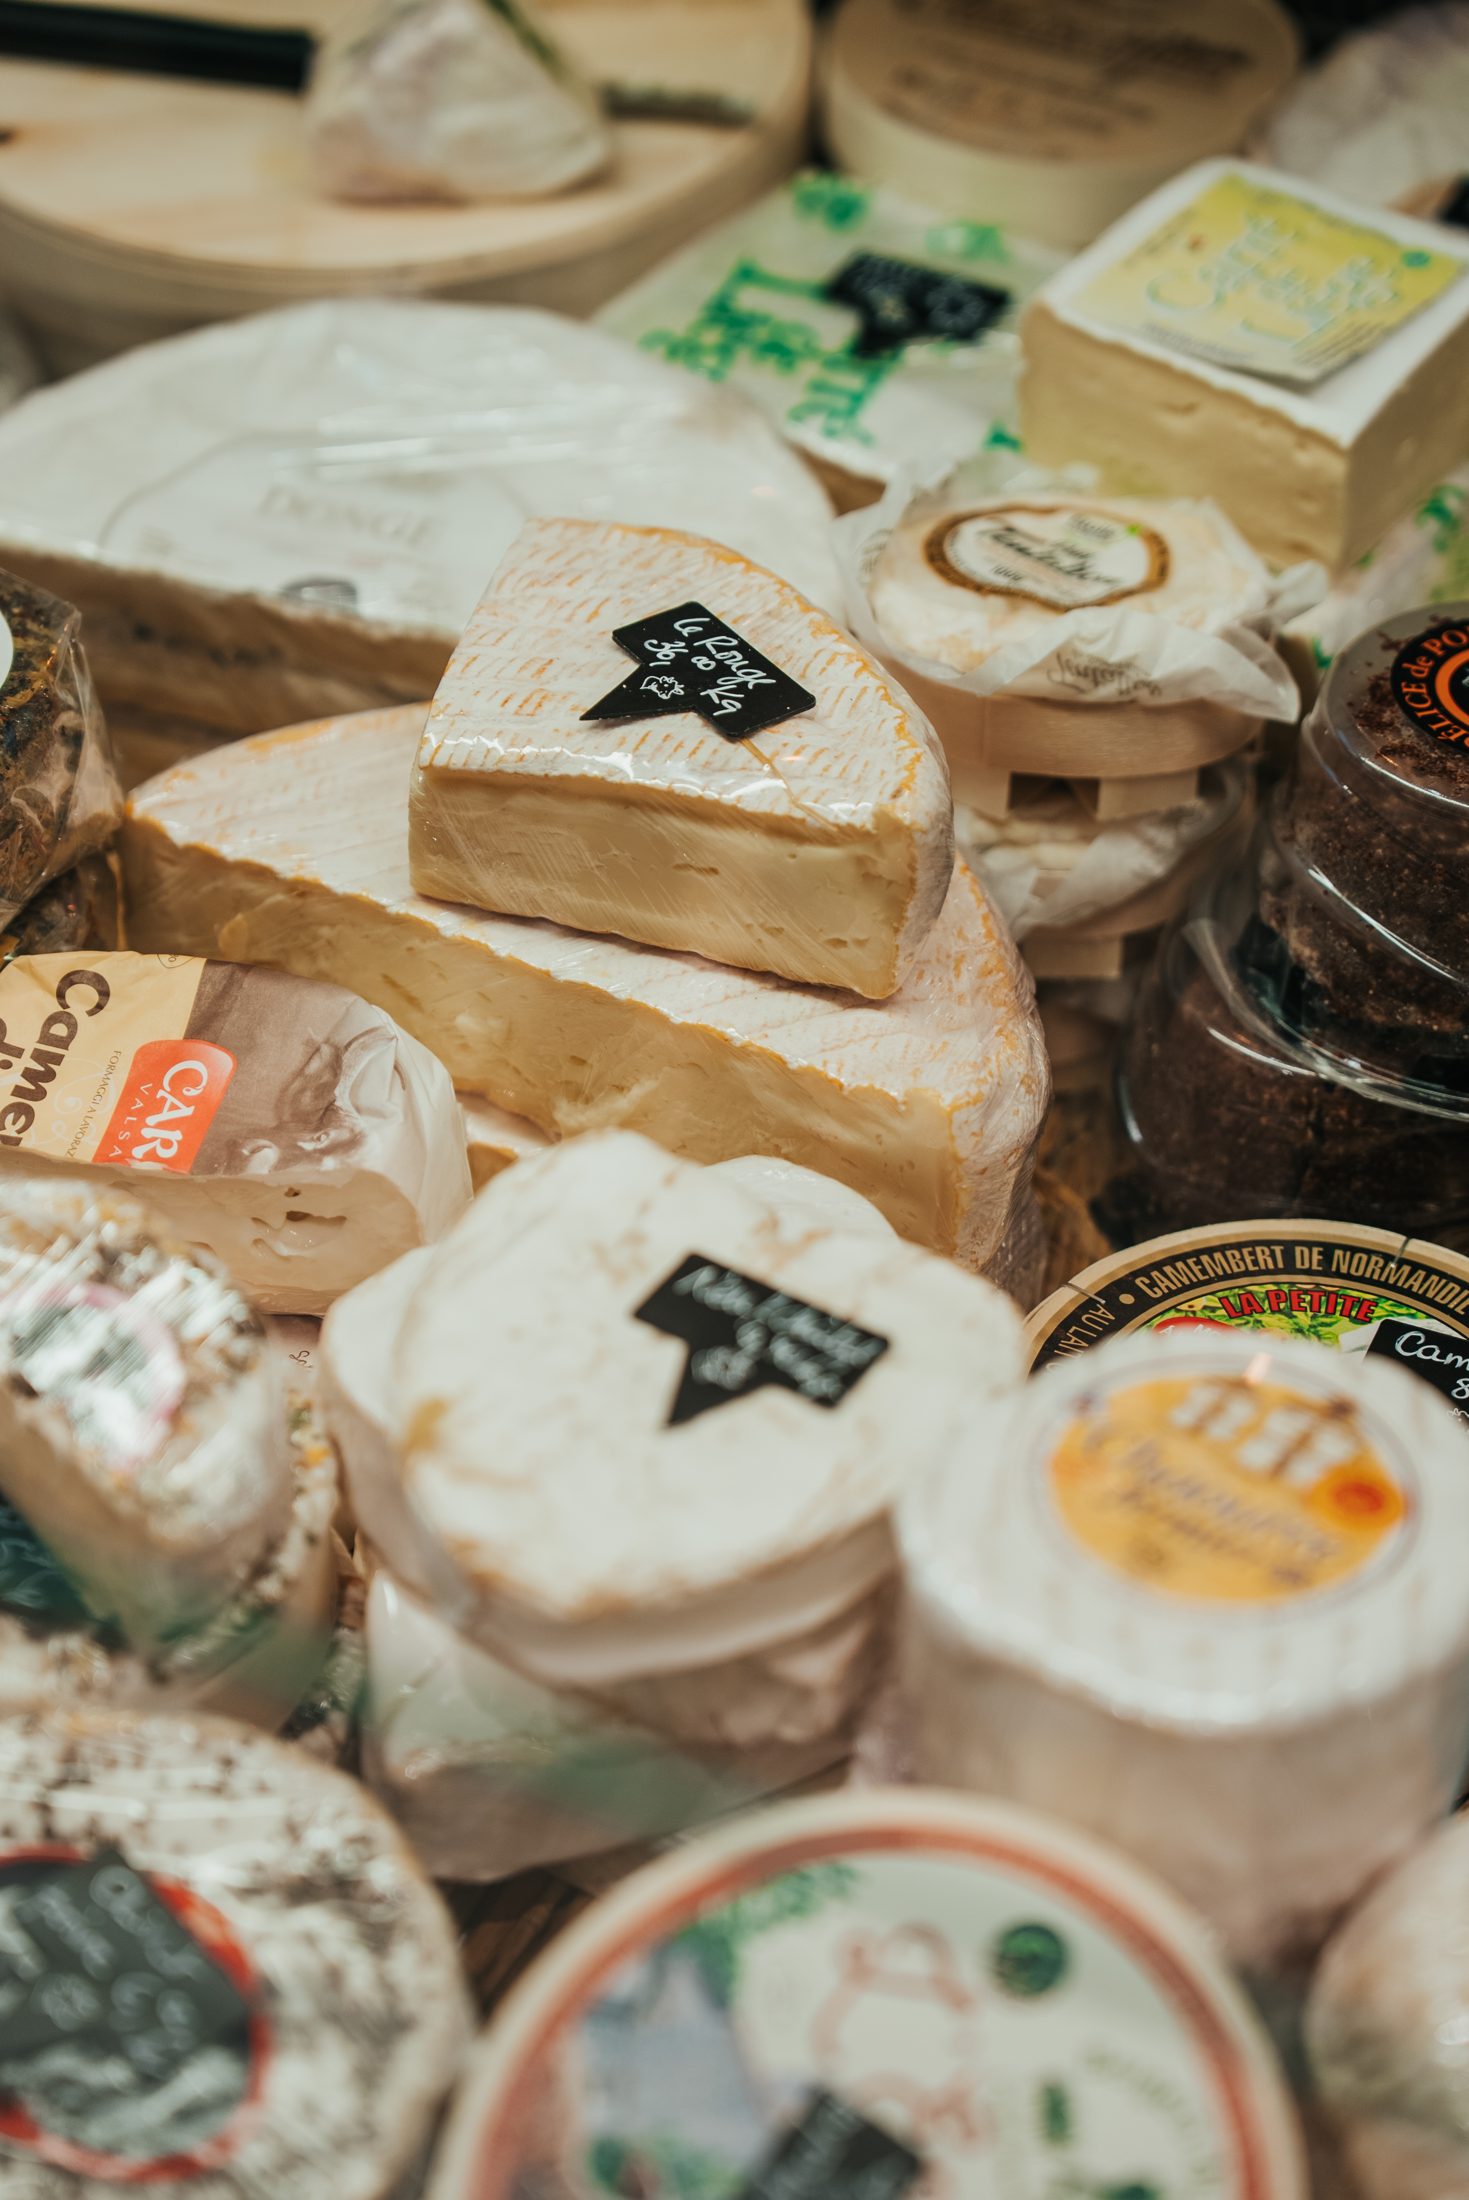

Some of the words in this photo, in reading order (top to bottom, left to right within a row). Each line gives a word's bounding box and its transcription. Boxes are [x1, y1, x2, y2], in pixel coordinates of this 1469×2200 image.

[673, 617, 711, 637] Le
[693, 635, 777, 690] Rouge
[1401, 655, 1435, 678] de
[1420, 626, 1469, 656] PO
[1401, 681, 1469, 748] ÉLICE
[91, 1050, 122, 1106] FORMAGGI
[1081, 1303, 1116, 1331] AU
[1134, 1245, 1285, 1299] CAMEMBERT
[1295, 1245, 1324, 1271] DE
[1217, 1291, 1266, 1319] LA
[1265, 1288, 1378, 1324] PETITE
